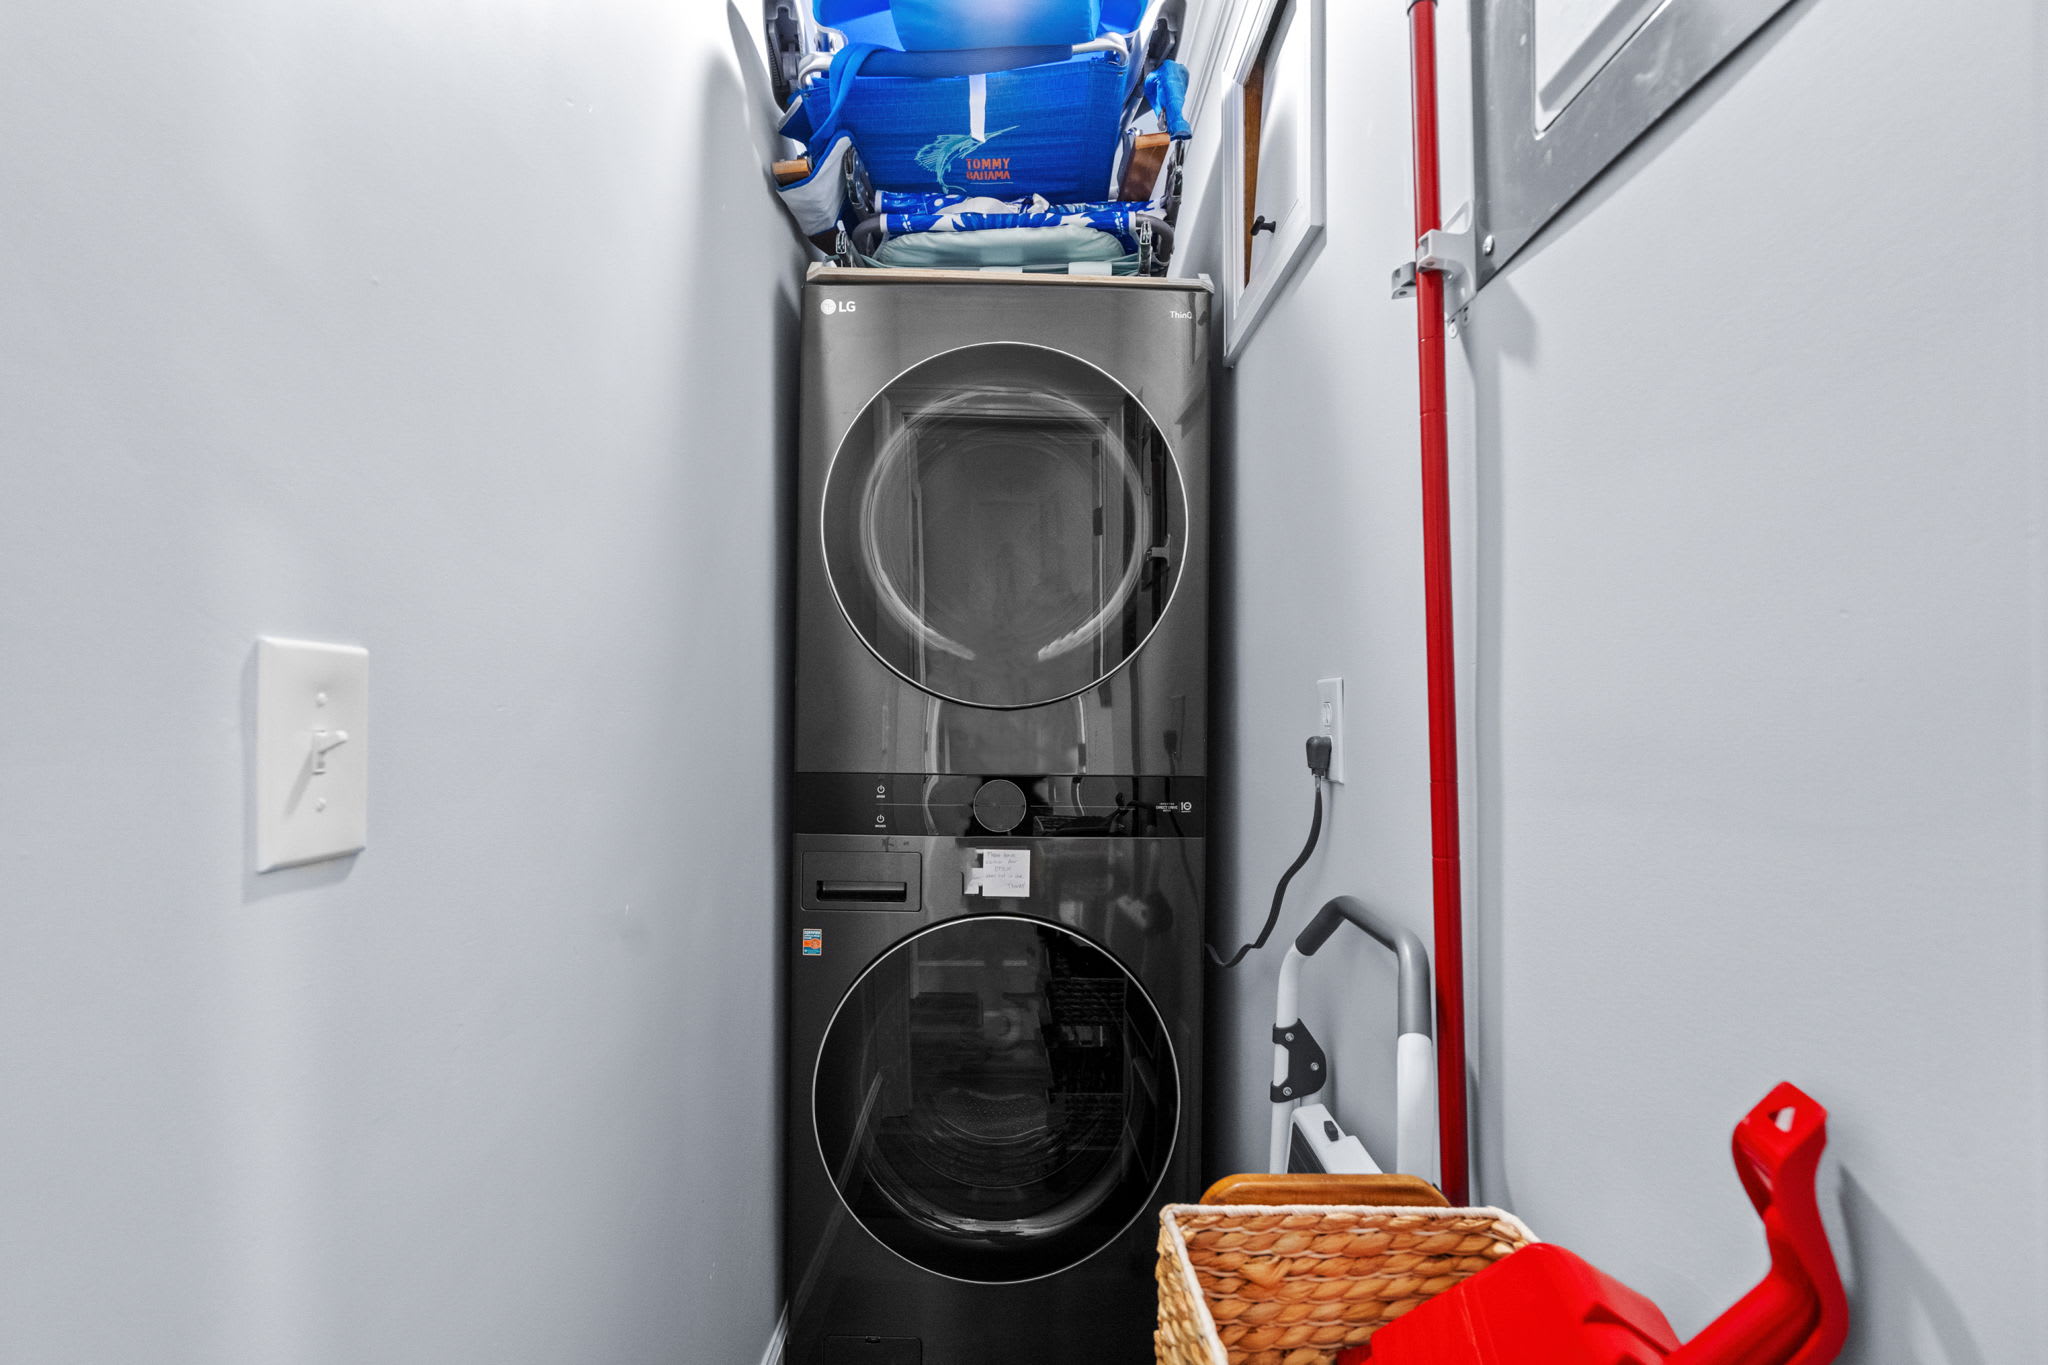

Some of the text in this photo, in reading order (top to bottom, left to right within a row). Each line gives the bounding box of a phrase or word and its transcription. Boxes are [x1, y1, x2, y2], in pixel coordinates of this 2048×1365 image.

[966, 158, 1010, 169] TOMMY
[966, 170, 1011, 180] BAHAMA
[838, 301, 856, 313] LG
